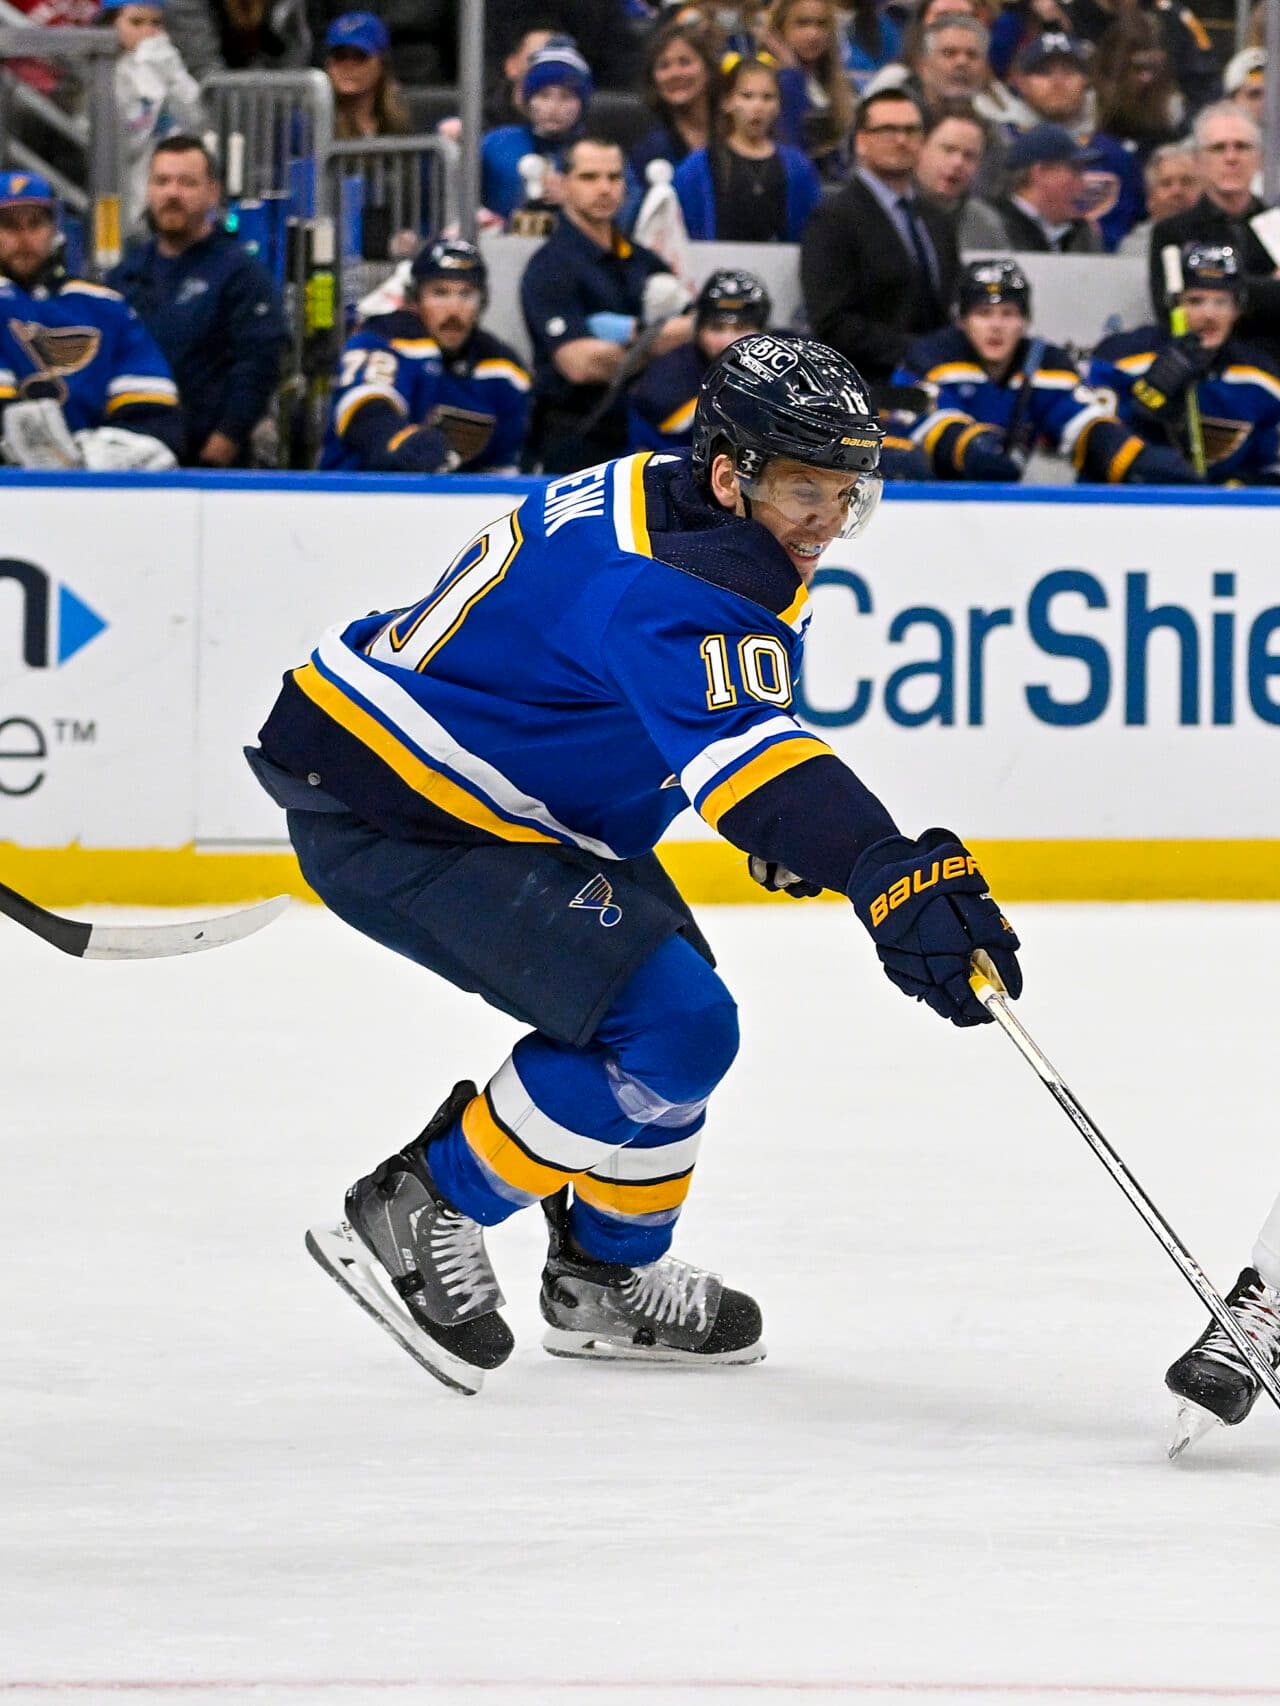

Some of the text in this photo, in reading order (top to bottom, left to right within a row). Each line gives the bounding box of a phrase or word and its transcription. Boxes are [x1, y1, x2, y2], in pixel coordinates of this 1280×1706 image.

[341, 348, 398, 386] 72
[750, 339, 796, 371] BJC
[840, 436, 878, 448] BAUER
[699, 633, 793, 711] 10
[869, 855, 984, 928] BAUER
